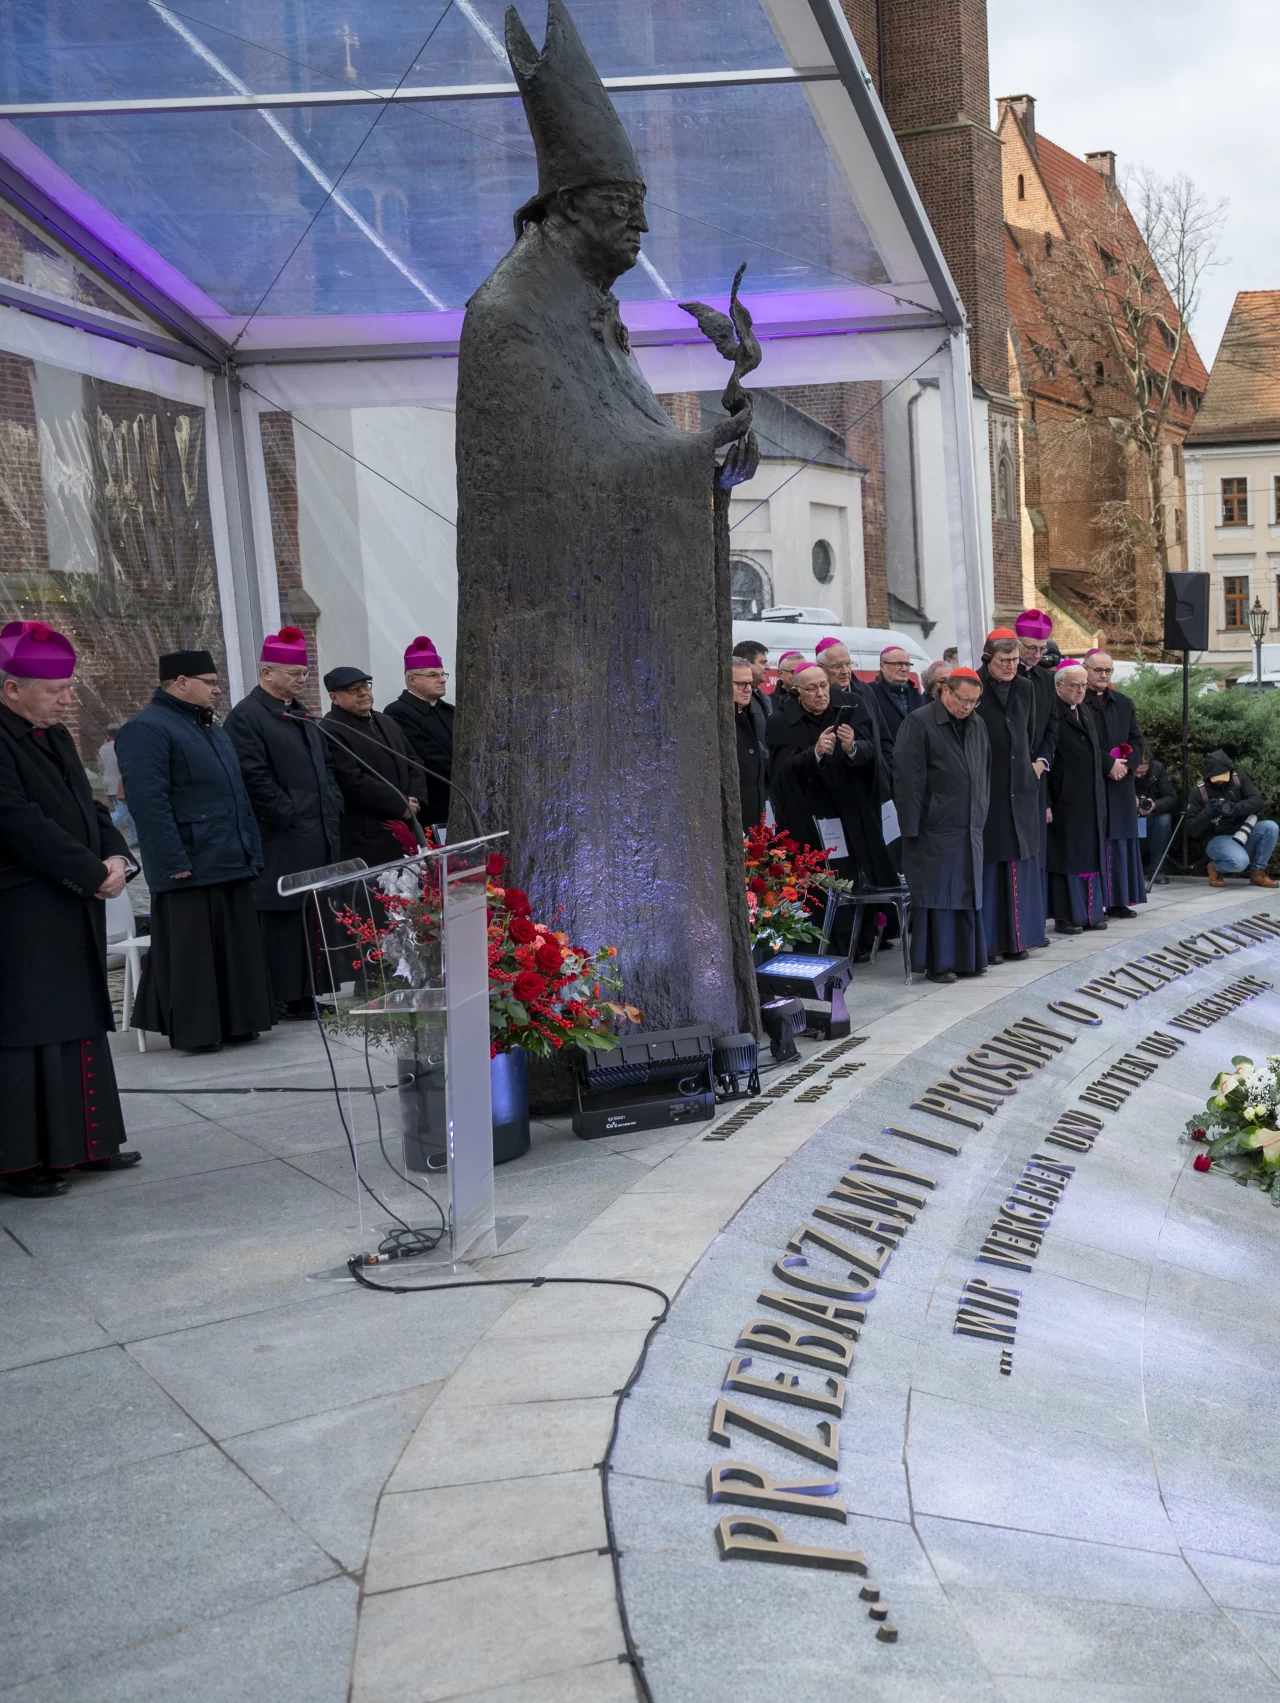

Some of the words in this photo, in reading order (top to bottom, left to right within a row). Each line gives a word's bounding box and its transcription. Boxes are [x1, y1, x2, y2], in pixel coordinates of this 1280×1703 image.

[1047, 999, 1103, 1026] O
[909, 1016, 1077, 1132] PROSIMY
[881, 1123, 962, 1157] I
[975, 1153, 1076, 1273] VERGEBEN
[1044, 1109, 1104, 1152] UND
[1078, 1053, 1159, 1112] BITTEN
[1135, 1030, 1187, 1059] UM
[1166, 974, 1274, 1034] VERGEBUNG
